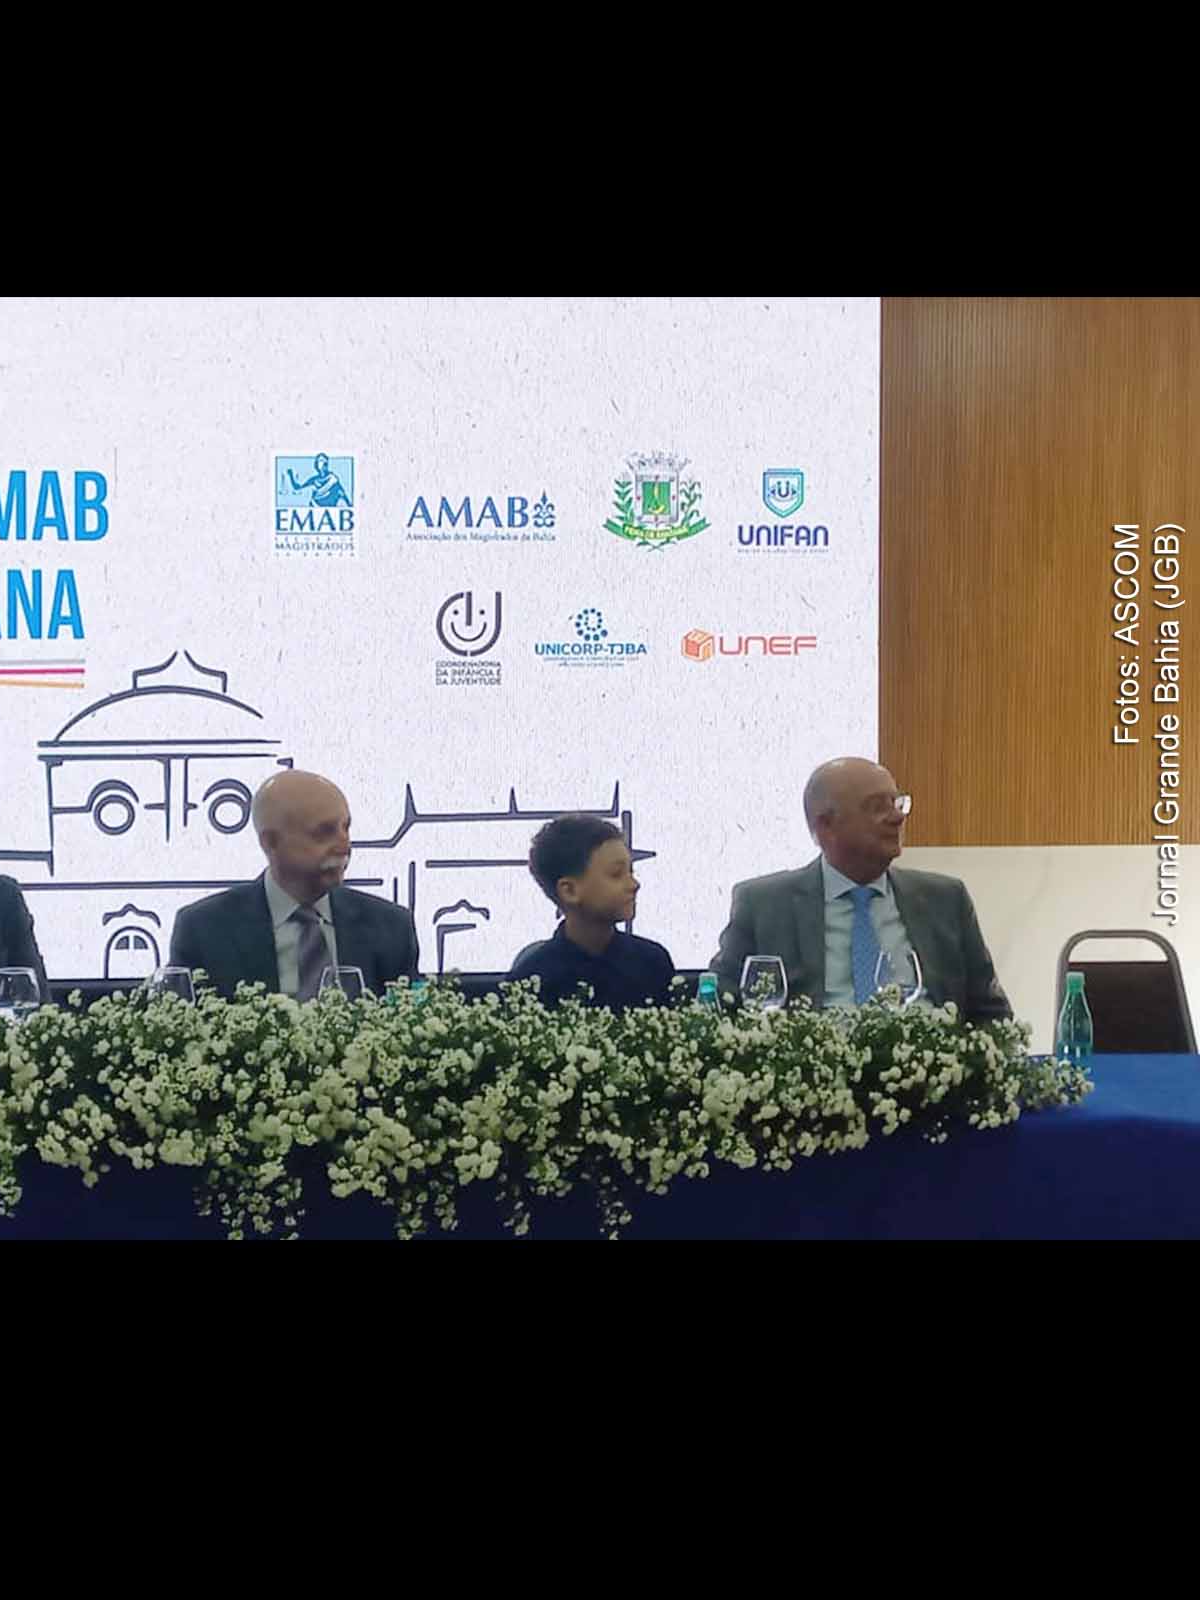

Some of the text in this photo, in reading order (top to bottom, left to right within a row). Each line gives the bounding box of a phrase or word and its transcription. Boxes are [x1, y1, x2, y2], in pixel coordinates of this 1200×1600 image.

[274, 508, 355, 532] EMAB
[406, 495, 529, 529] AMAB
[737, 524, 830, 547] UNIFAN
[534, 642, 648, 656] UNICORP-TJBA
[719, 636, 817, 656] UNEF
